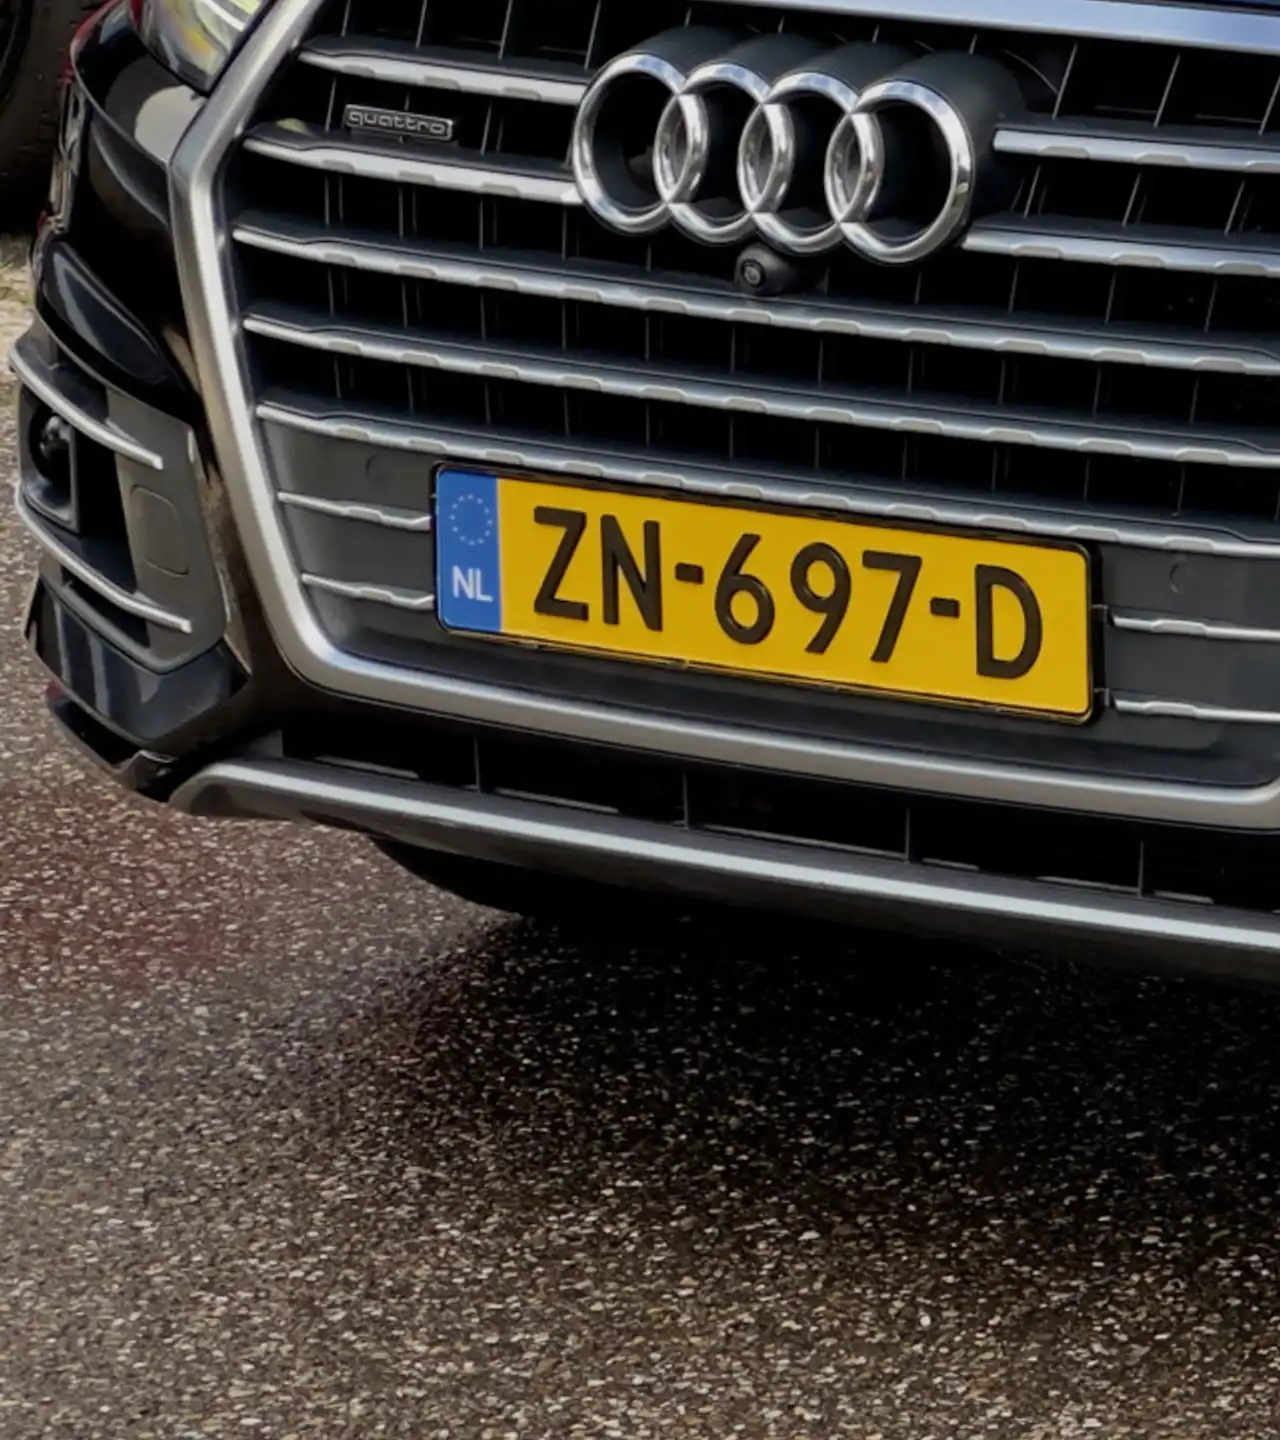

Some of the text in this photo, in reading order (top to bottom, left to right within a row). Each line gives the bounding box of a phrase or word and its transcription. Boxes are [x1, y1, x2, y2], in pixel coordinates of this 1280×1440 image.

[347, 111, 446, 135] quattro
[452, 565, 492, 604] NL
[533, 504, 1044, 681] ZN-697-D
